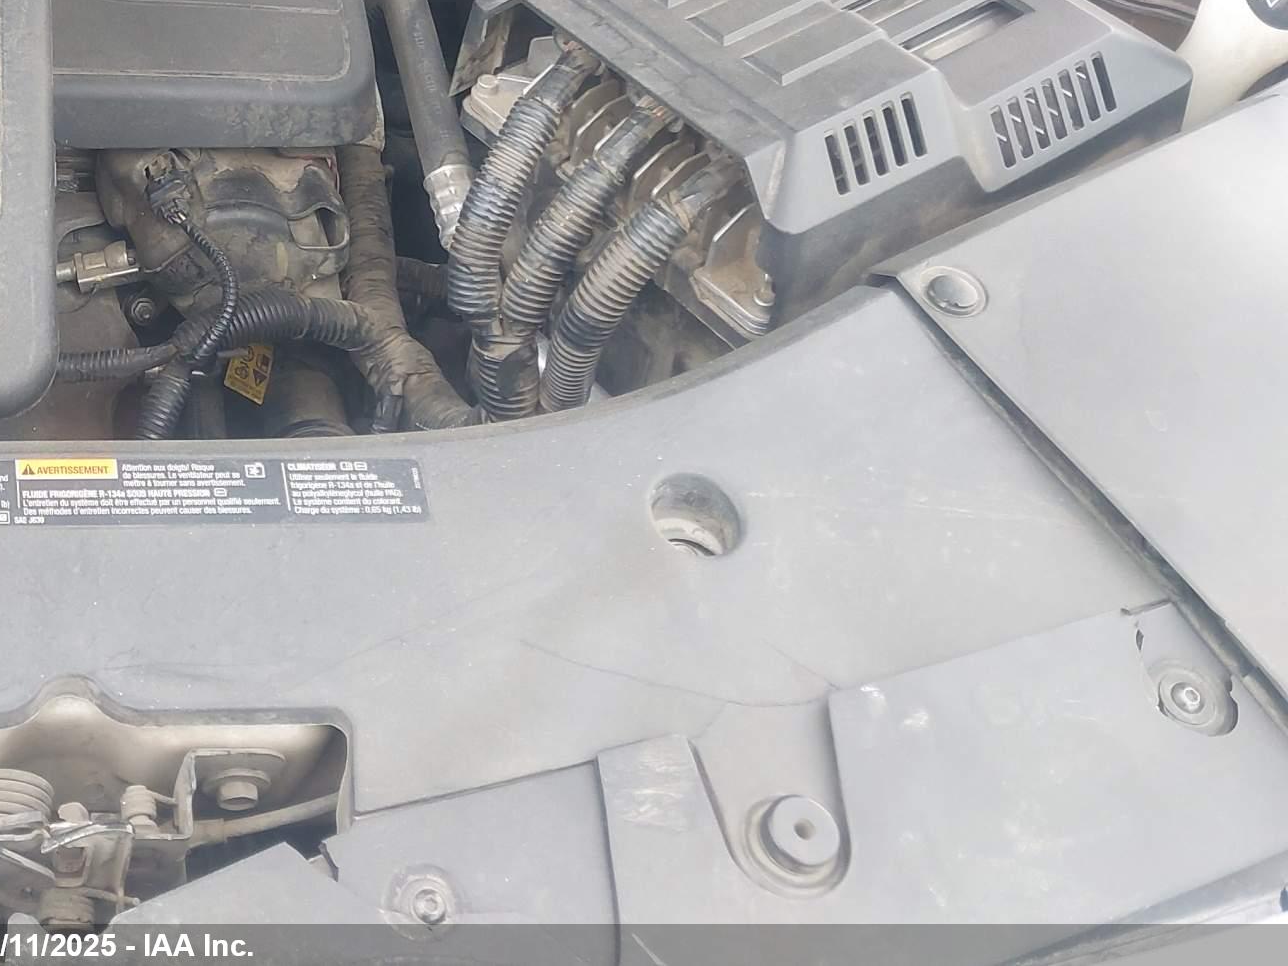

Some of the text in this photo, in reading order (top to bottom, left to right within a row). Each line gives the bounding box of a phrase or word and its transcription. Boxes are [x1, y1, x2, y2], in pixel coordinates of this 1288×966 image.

[37, 466, 109, 474] AVERTISSEMENT
[122, 464, 152, 472] Attention
[148, 489, 173, 497] HAUTE
[173, 489, 211, 497] PRESSION
[100, 498, 113, 506] doit
[159, 499, 170, 507] par
[182, 498, 216, 507] personnel
[111, 507, 150, 515] incorrectes
[150, 508, 178, 516] peuvent
